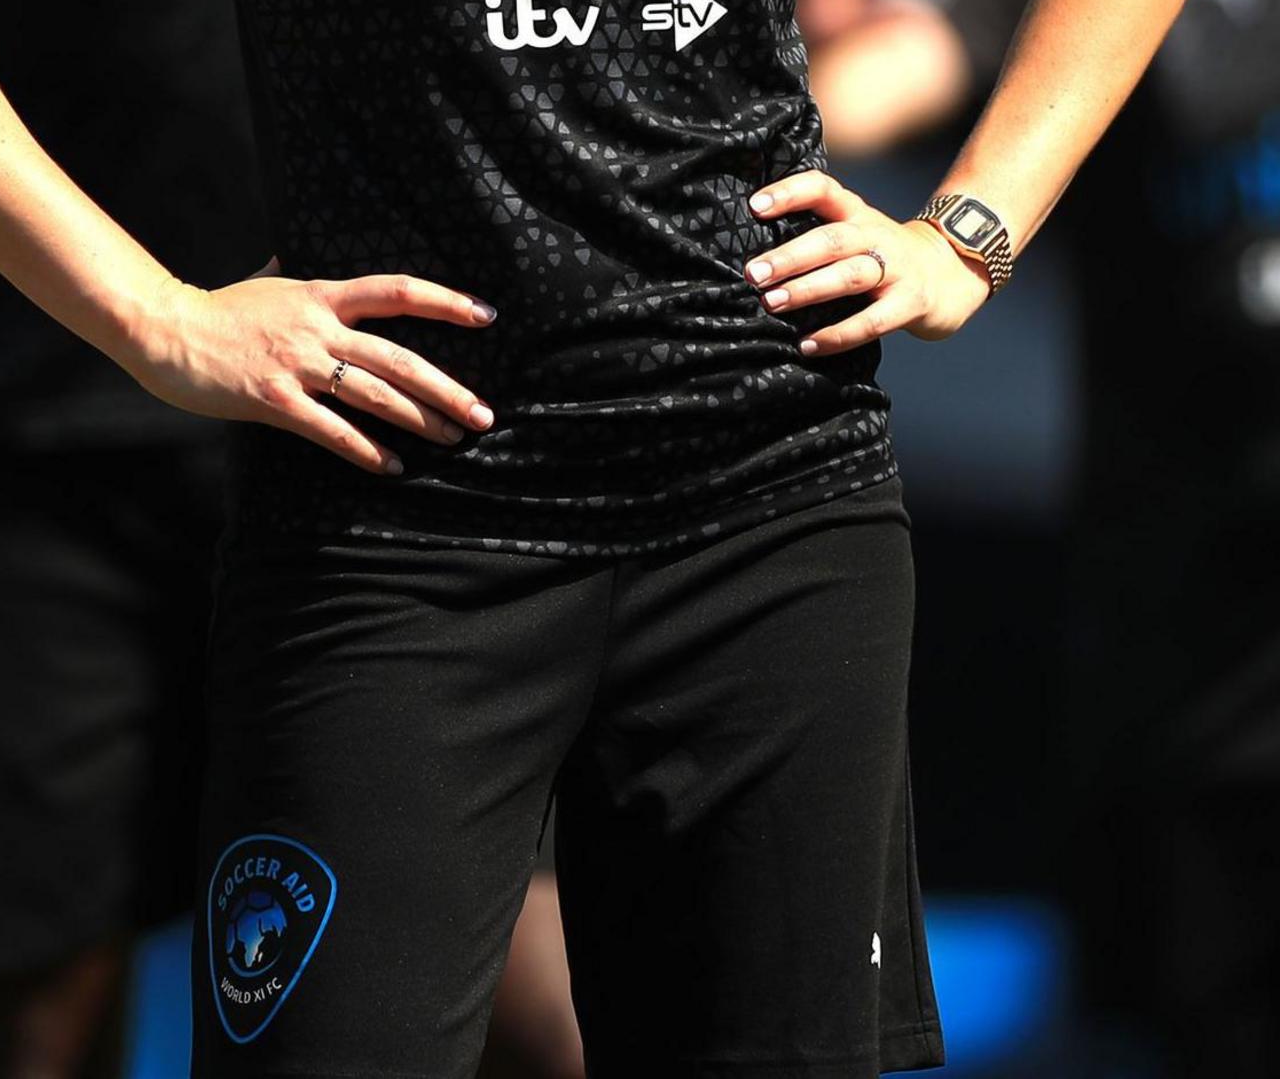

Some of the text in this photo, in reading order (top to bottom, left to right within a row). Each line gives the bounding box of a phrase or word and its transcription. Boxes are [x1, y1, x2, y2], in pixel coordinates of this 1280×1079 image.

[218, 857, 316, 914] SOCCER AID
[220, 976, 283, 1004] WORLD XI FC
